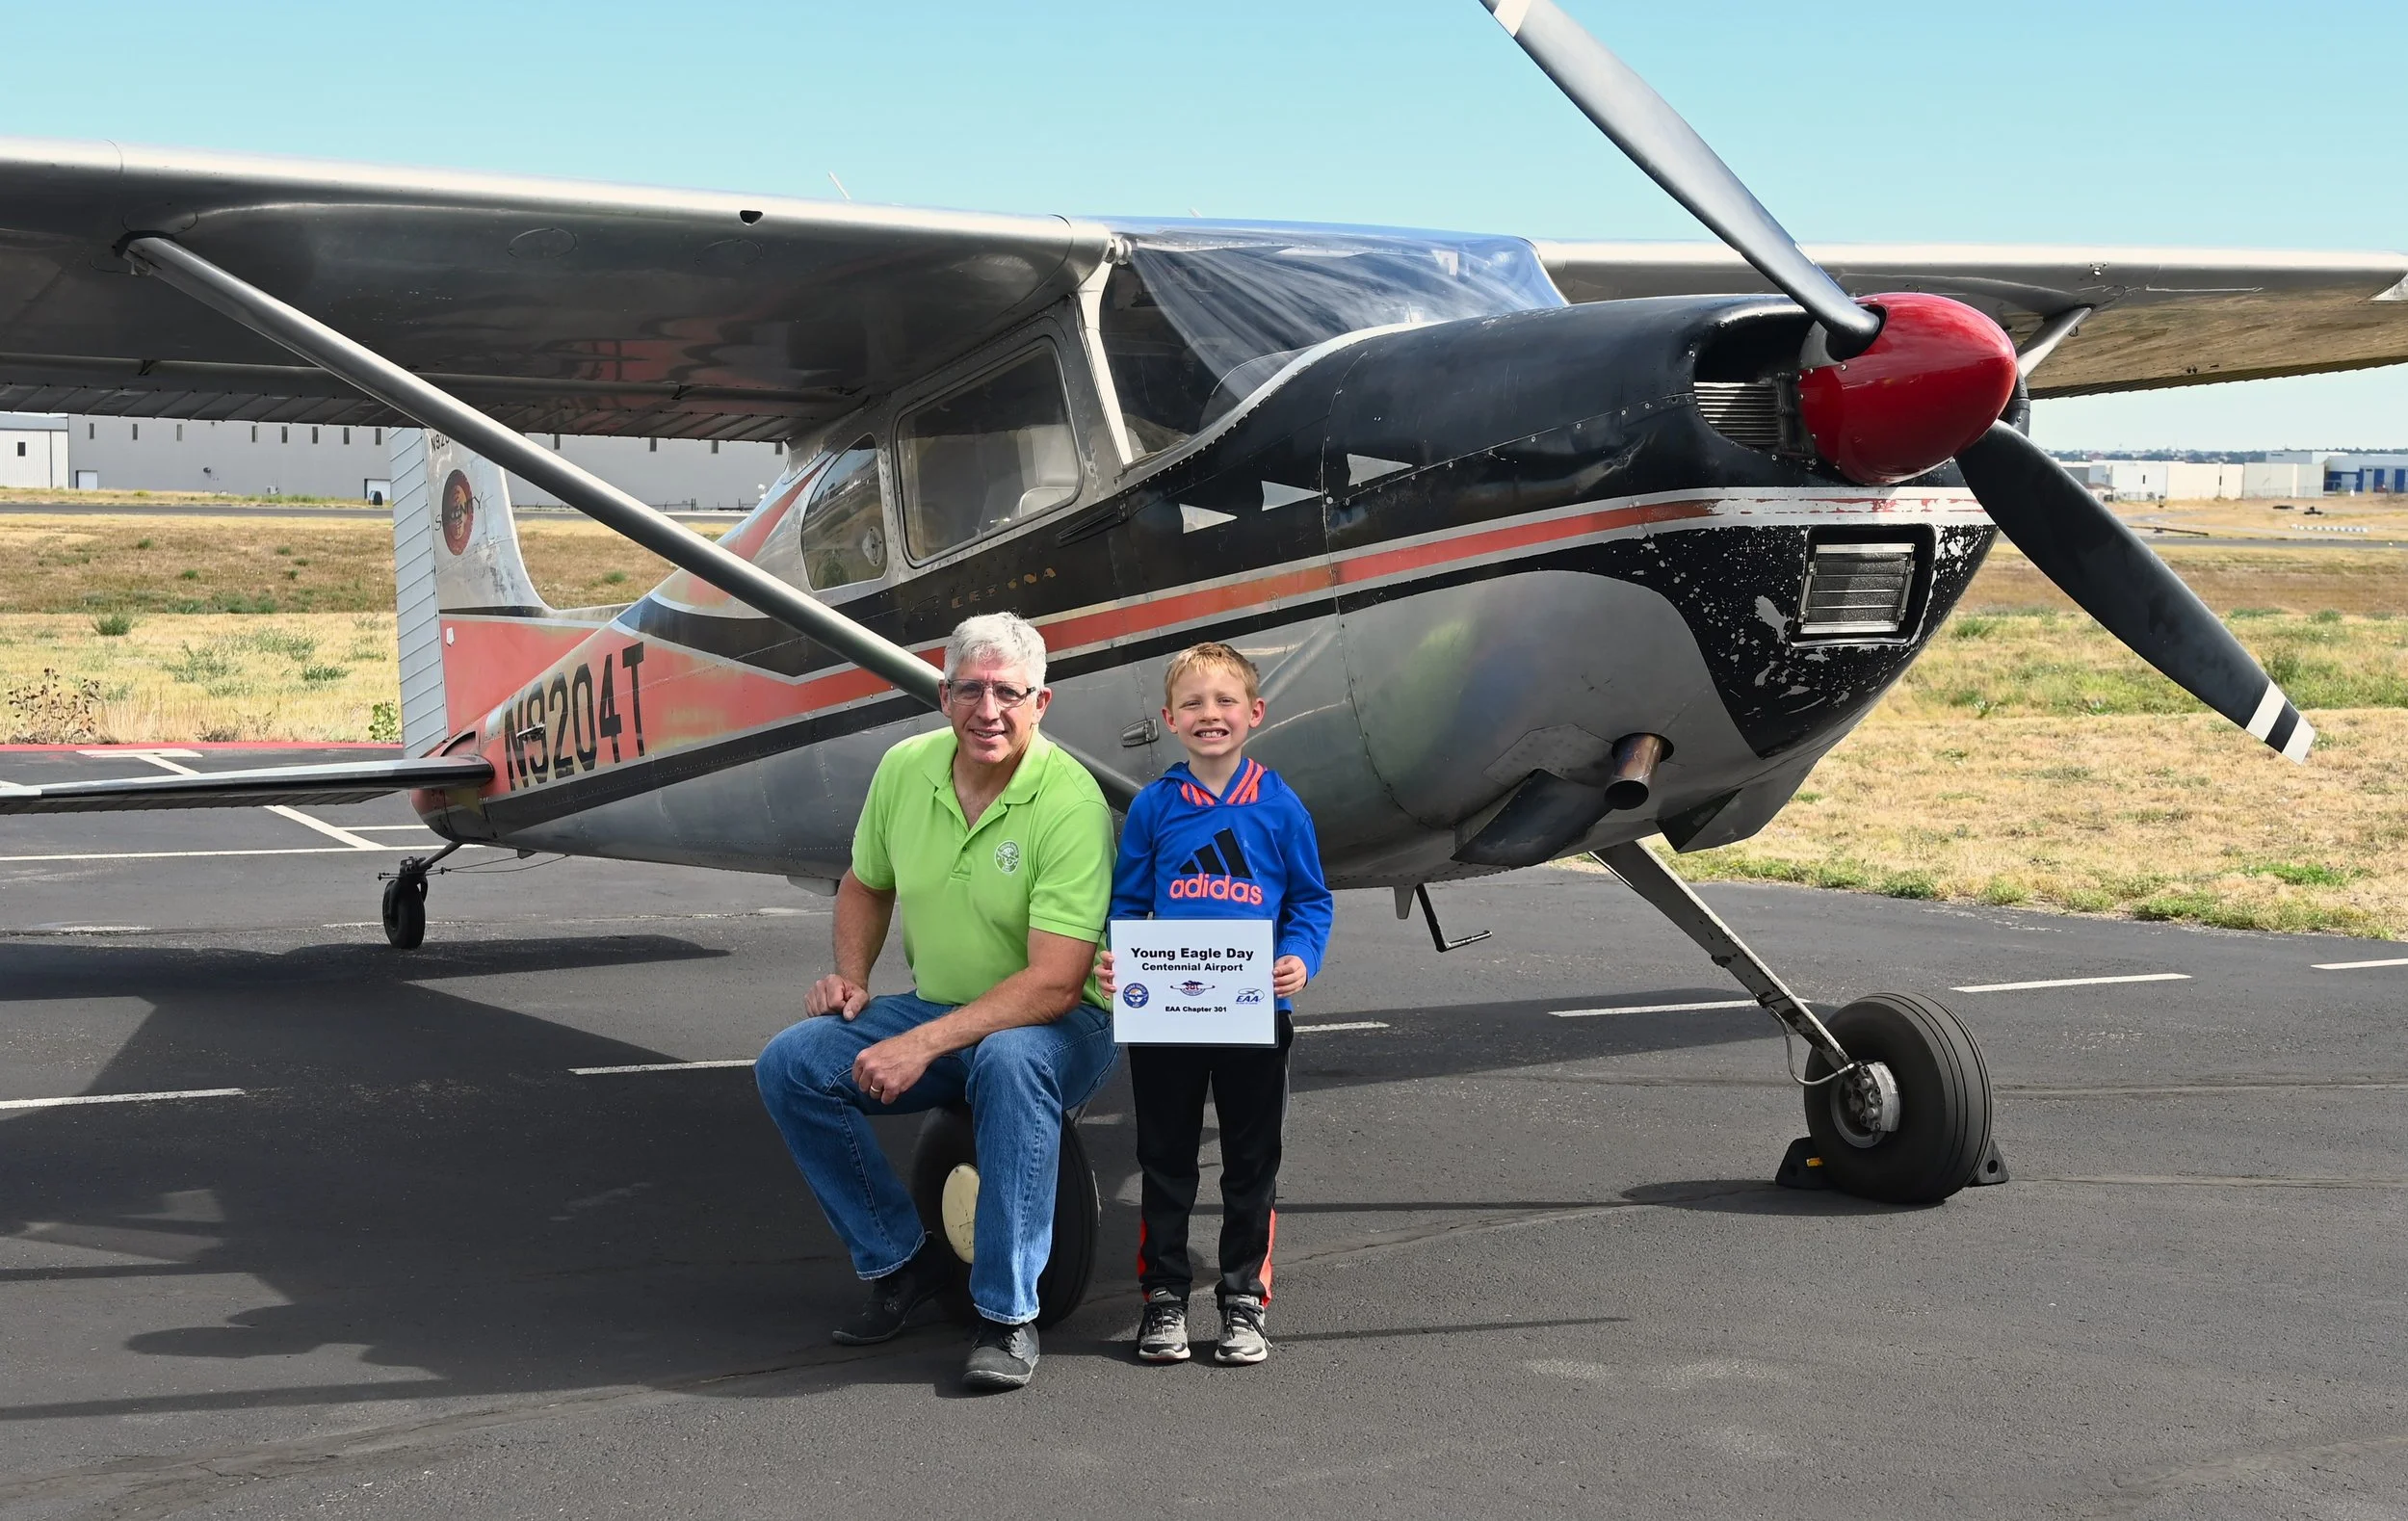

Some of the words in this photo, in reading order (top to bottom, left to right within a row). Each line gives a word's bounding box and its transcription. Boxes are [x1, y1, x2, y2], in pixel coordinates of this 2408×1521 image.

[434, 491, 484, 531] SENITY
[505, 642, 645, 793] N9204T
[1168, 873, 1264, 905] adidas
[1130, 947, 1176, 961] Young
[1180, 947, 1221, 961] Eagle
[1226, 947, 1254, 961] Day
[1141, 962, 1201, 971] Centennial
[1204, 962, 1243, 973] Airport
